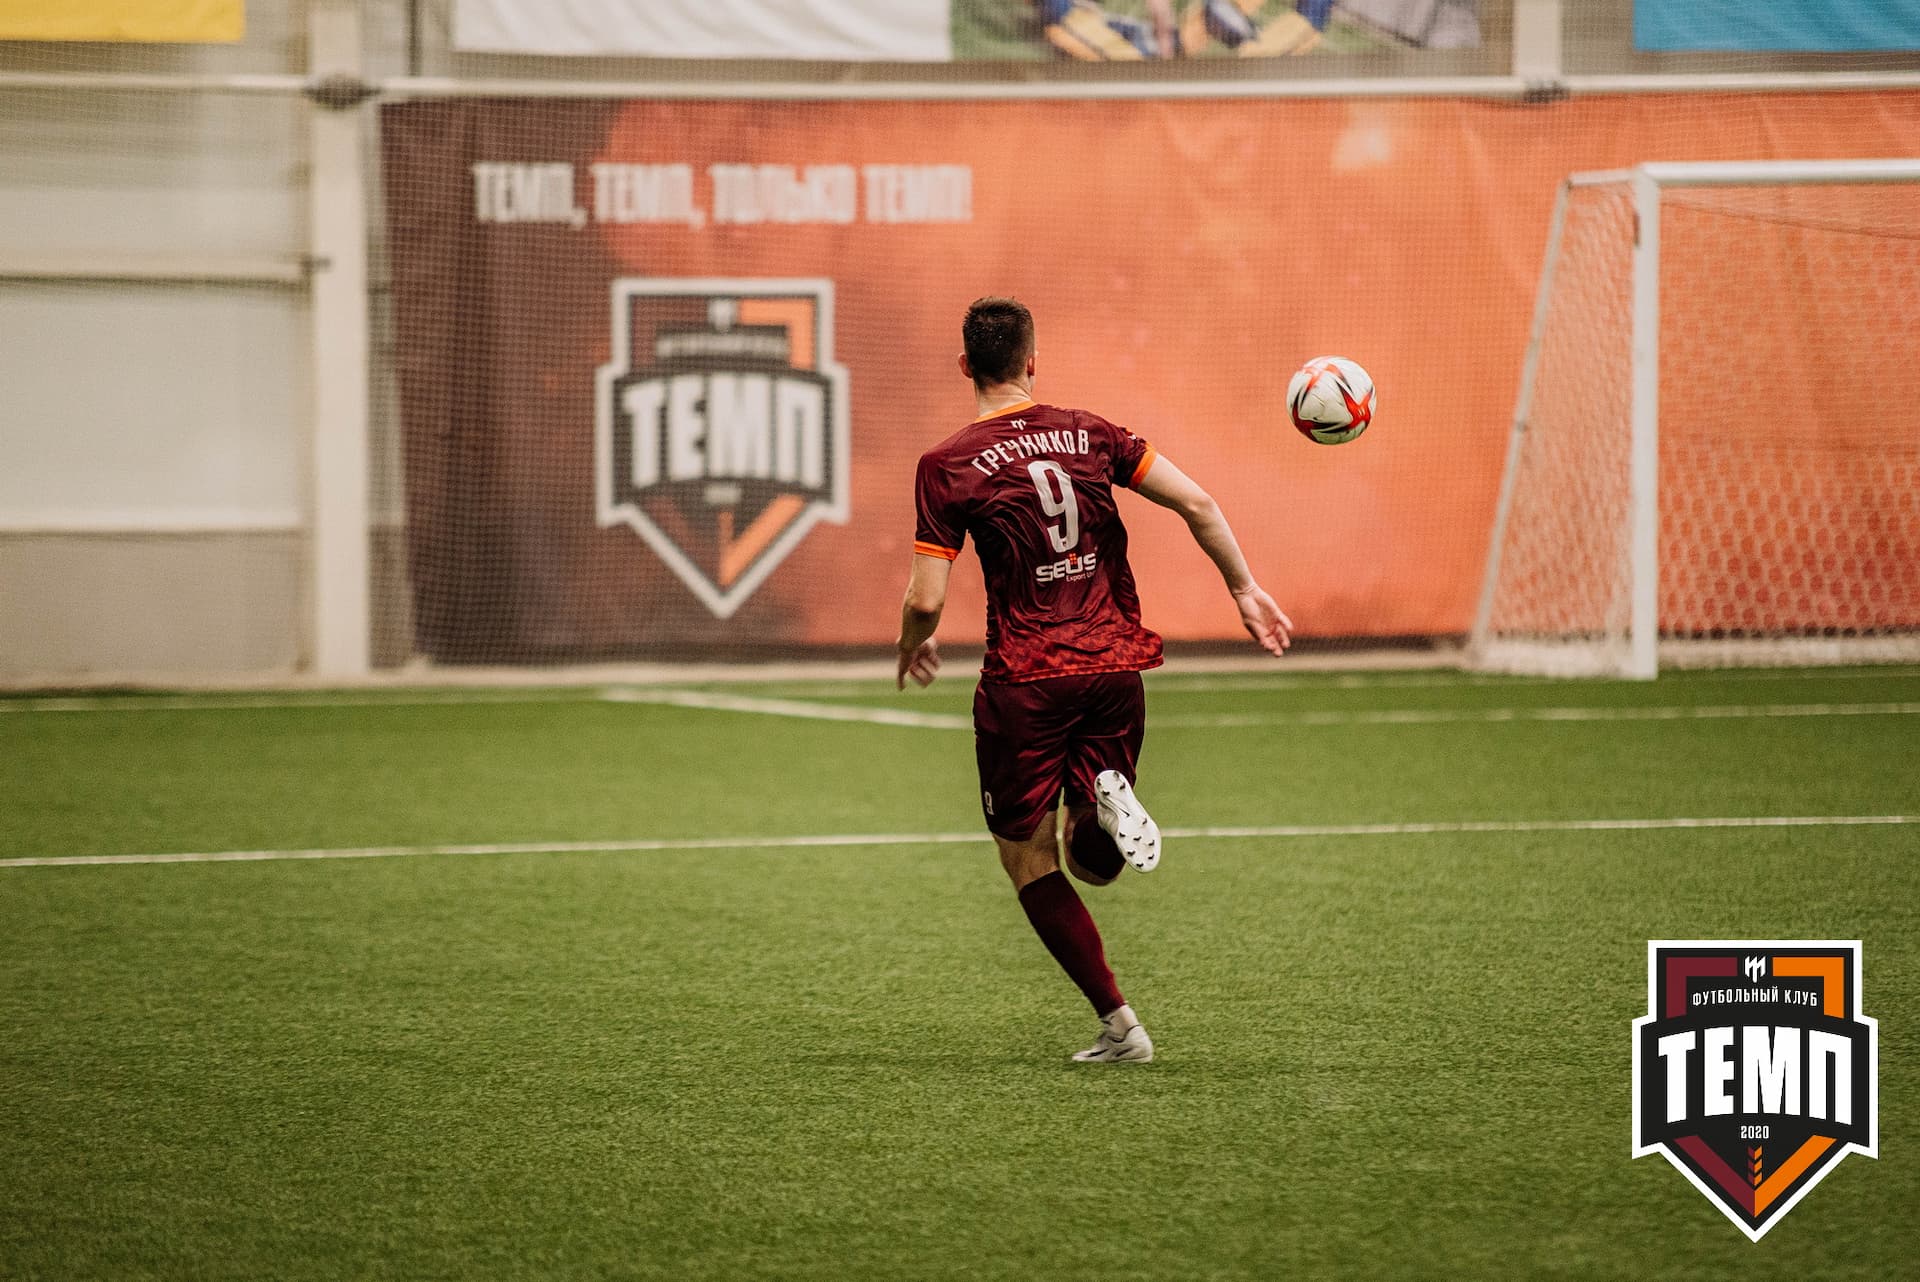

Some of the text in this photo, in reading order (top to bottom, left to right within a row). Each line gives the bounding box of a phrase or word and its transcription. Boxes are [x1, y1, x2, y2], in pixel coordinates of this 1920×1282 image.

[622, 373, 824, 490] ТЕМП
[971, 429, 1089, 477] ГРЕЧНИКОВ
[1027, 460, 1079, 553] 9
[984, 791, 994, 816] 9
